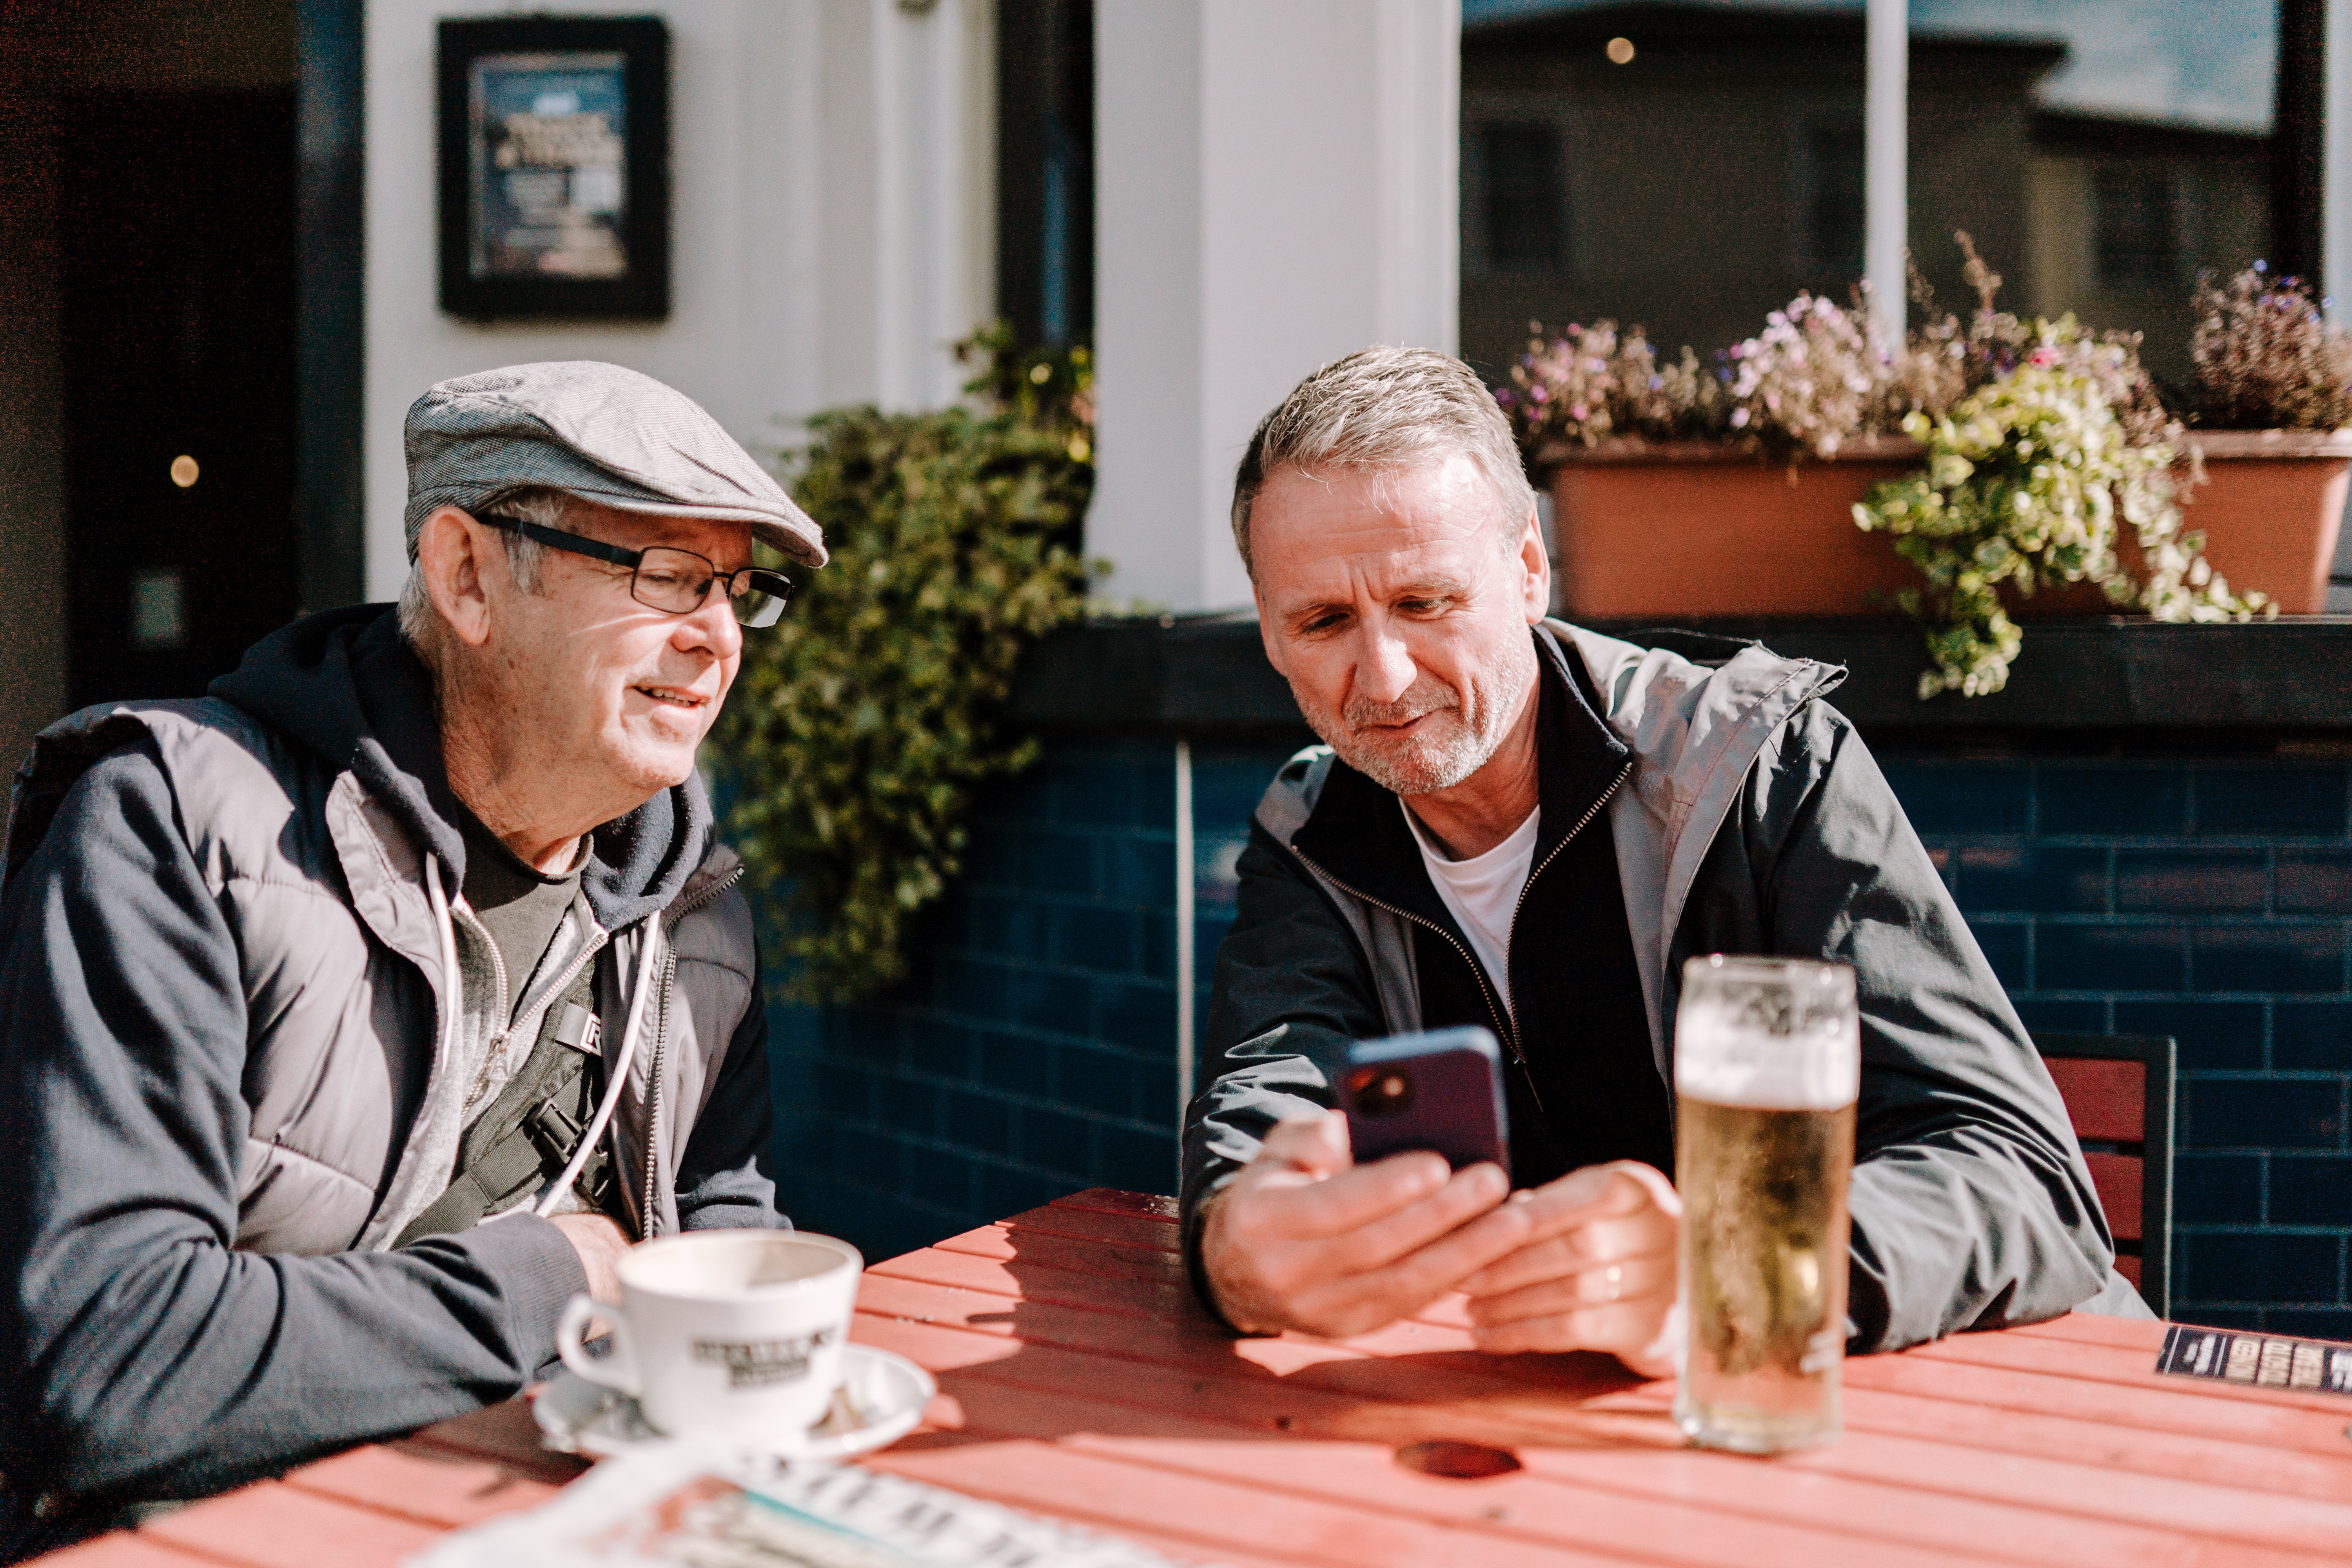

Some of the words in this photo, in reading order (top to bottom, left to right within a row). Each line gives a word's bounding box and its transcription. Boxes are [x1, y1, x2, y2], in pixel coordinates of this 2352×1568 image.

[2228, 1339, 2261, 1365] NEED
[2262, 1342, 2292, 1356] TO
[2260, 1355, 2290, 1370] GO
[2258, 1369, 2288, 1385] TO
